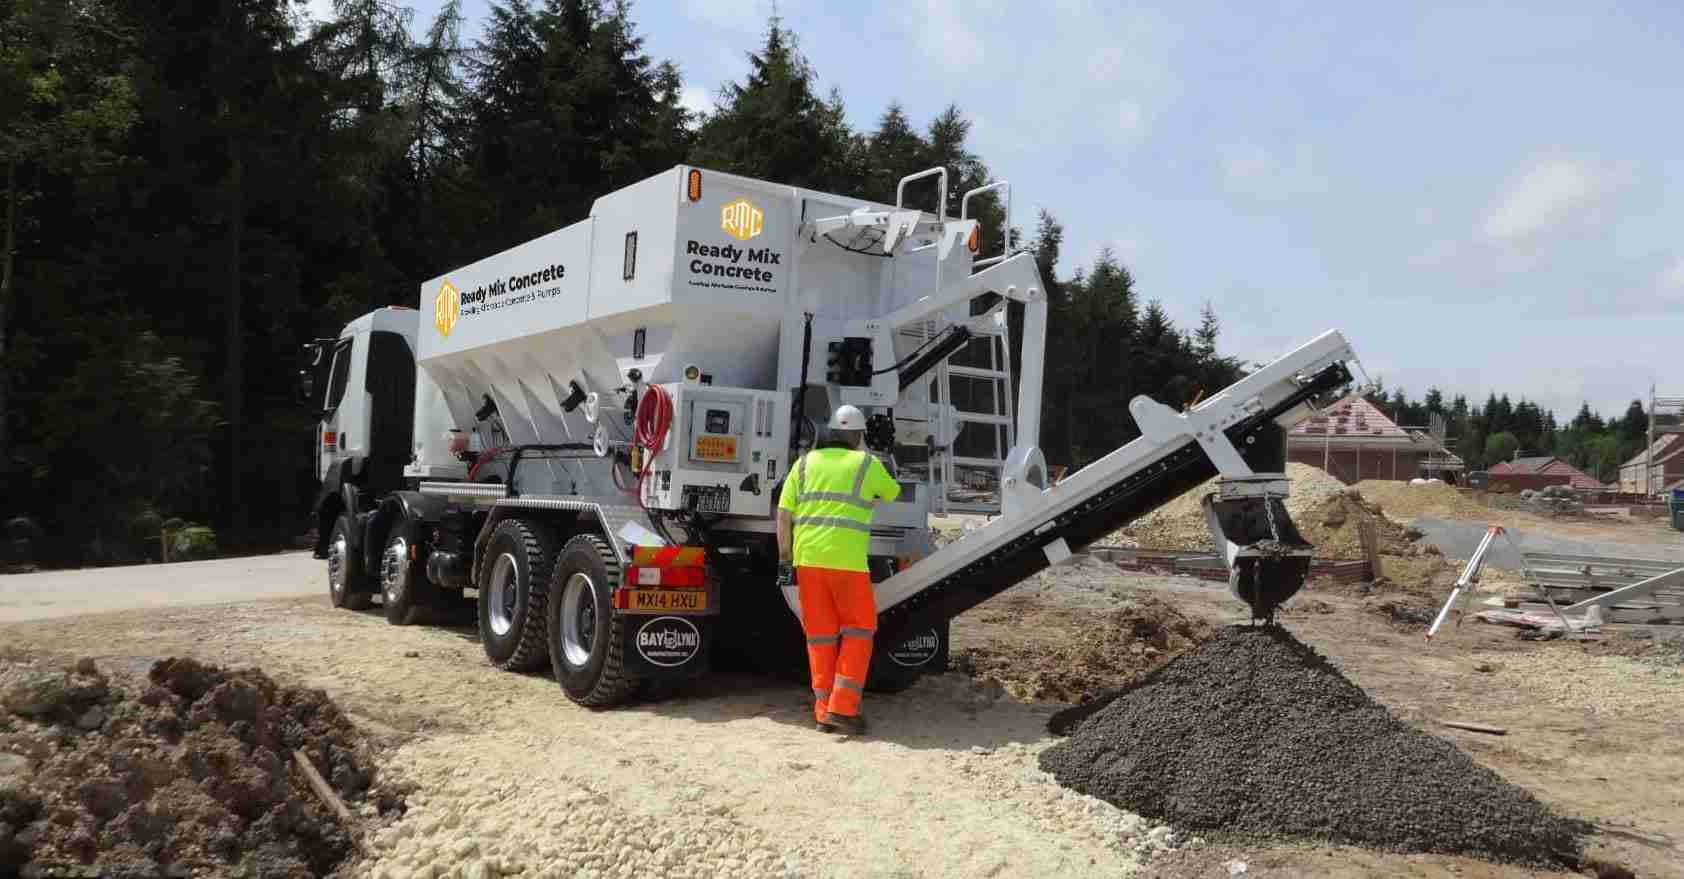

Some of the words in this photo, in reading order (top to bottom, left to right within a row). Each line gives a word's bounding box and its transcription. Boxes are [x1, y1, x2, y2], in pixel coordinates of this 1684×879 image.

[687, 240, 743, 263] Ready
[748, 248, 781, 264] Mix
[690, 259, 773, 282] Concrete
[460, 286, 486, 306] Ready
[489, 279, 506, 298] Mix
[508, 264, 565, 292] Concrete
[640, 632, 664, 647] BAY
[677, 632, 696, 647] LYNX
